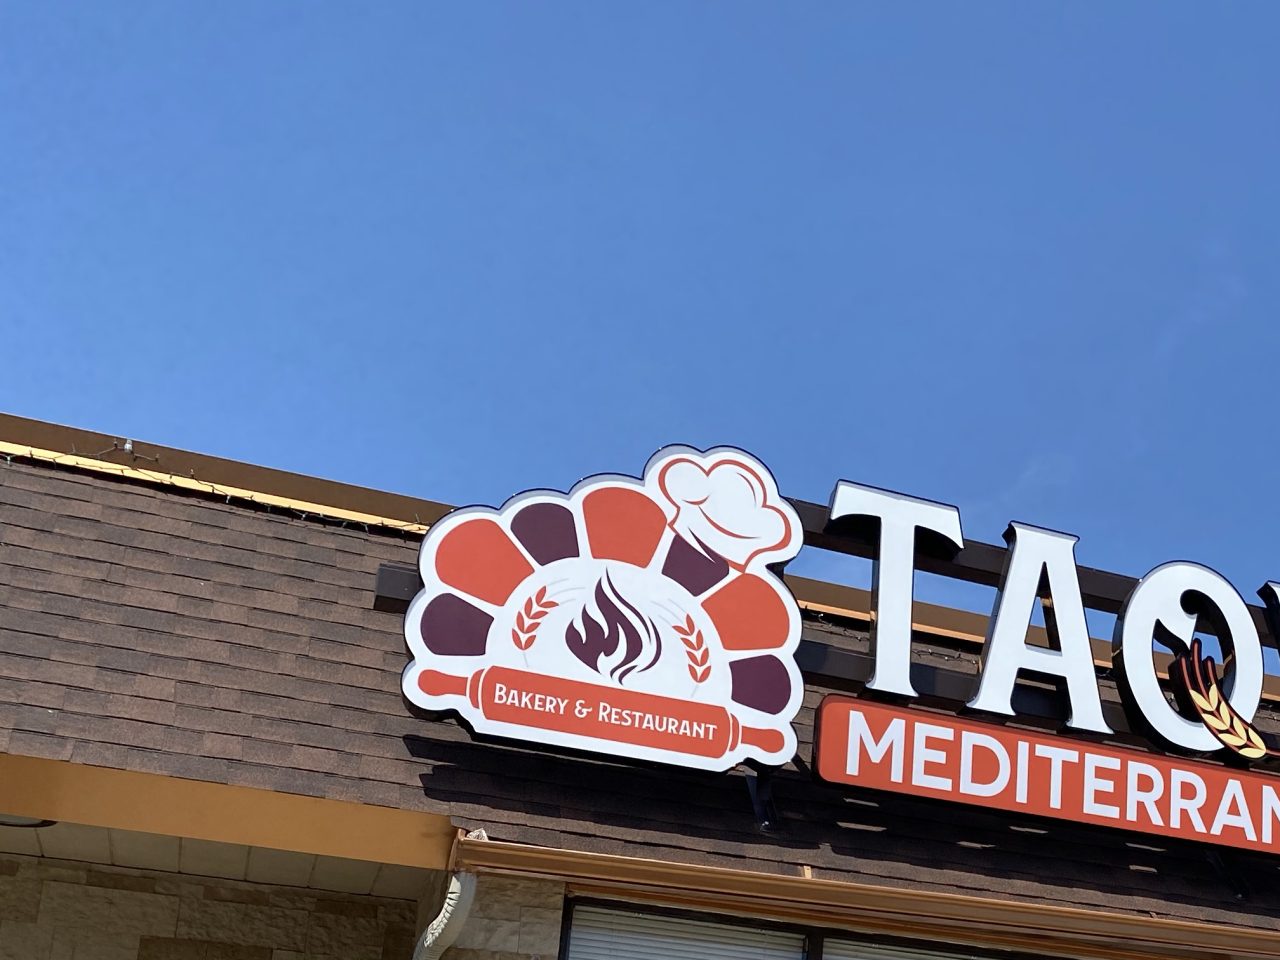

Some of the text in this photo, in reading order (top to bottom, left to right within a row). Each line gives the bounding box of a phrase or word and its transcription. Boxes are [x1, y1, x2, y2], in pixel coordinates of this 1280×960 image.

[493, 682, 718, 741] BAKERY & RESTAURANT
